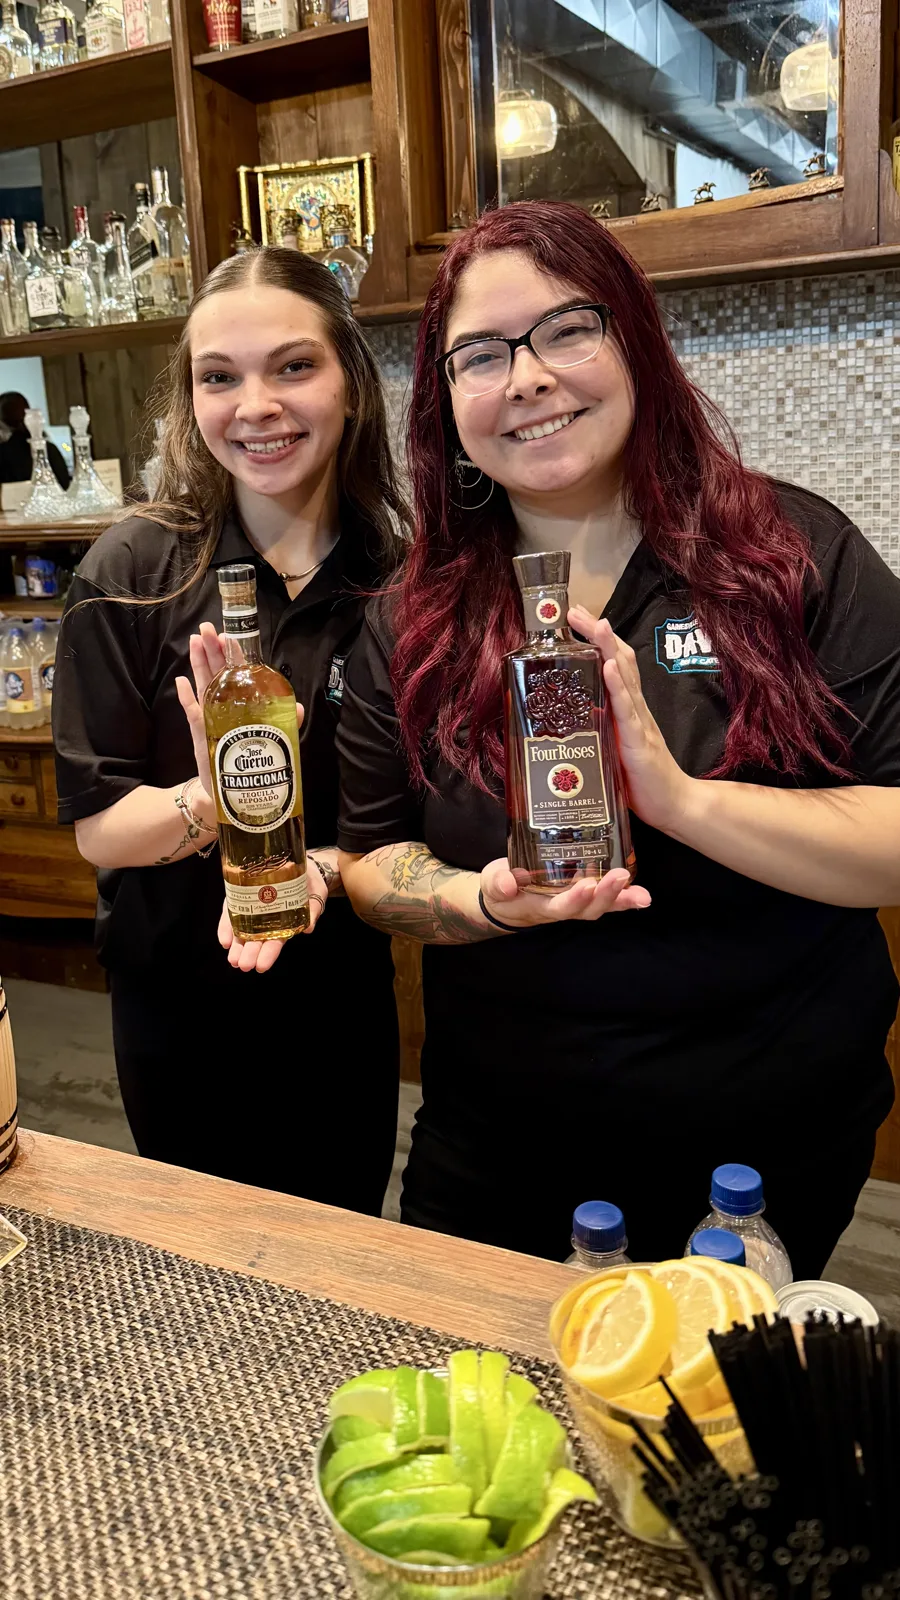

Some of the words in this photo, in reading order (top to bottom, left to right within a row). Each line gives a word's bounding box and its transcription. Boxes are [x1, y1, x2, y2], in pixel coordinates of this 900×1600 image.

[226, 732, 244, 746] 100%
[260, 731, 281, 742] AGAVE
[246, 748, 263, 759] Jose
[234, 754, 274, 772] Cuervo
[223, 770, 288, 788] TRADICIONAL
[238, 795, 280, 804] REPOSADO
[241, 790, 275, 799] TEQUILA
[539, 800, 567, 808] SINGLE
[568, 798, 597, 807] BARREL
